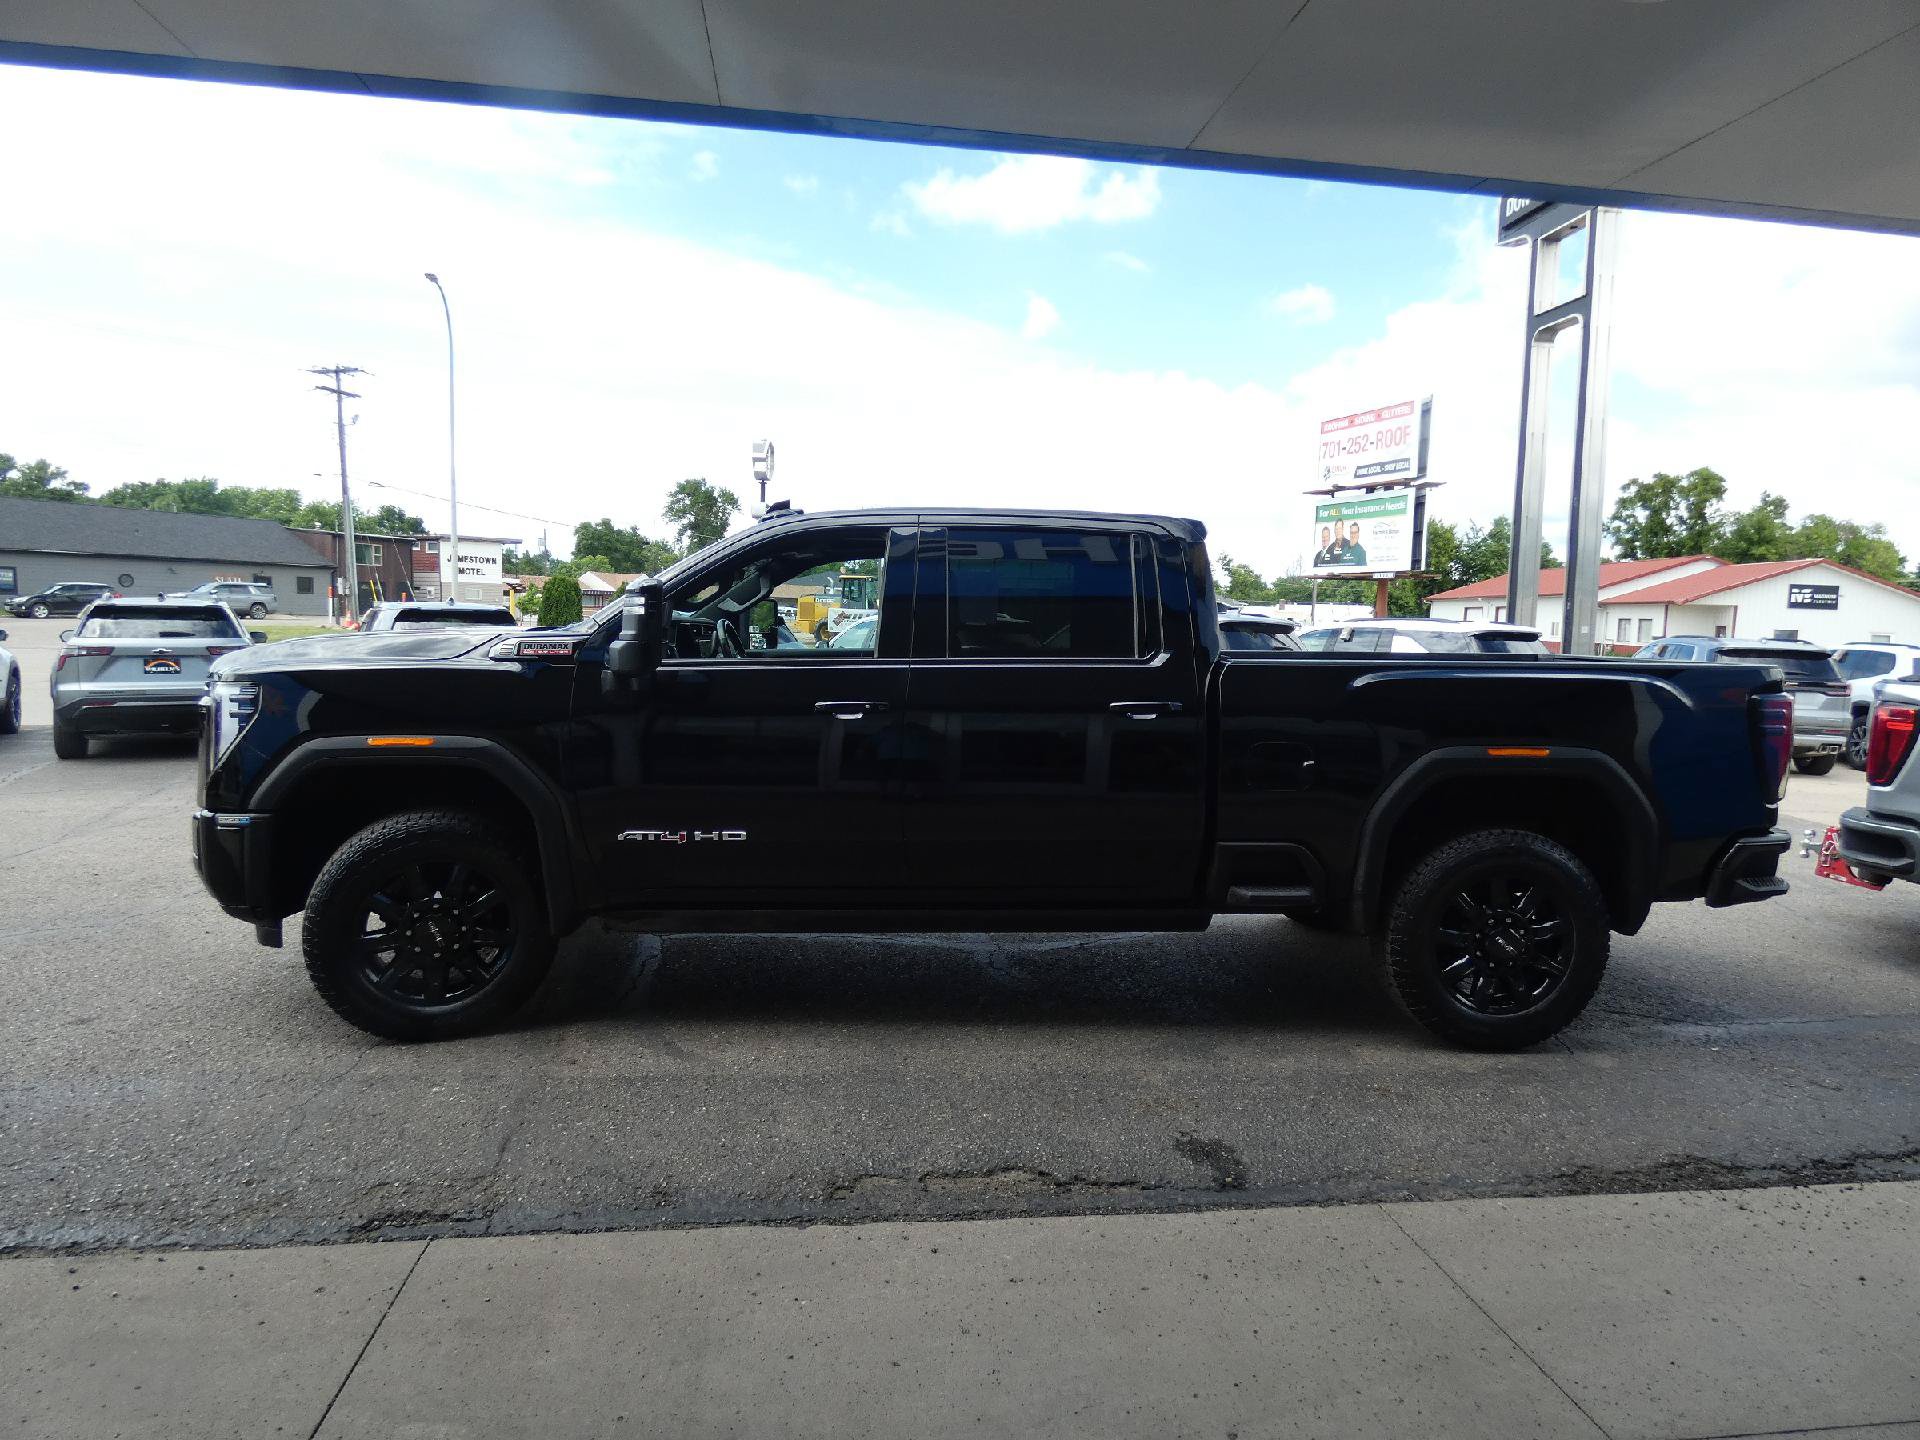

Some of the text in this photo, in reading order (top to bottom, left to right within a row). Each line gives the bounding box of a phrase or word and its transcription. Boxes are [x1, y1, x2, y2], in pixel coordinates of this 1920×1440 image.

[1322, 425, 1411, 459] 701-252-ROOF
[1320, 509, 1329, 517] For
[1330, 508, 1340, 516] ALL
[1355, 503, 1385, 514] Insurance
[447, 554, 497, 565] JMESTOWN
[458, 567, 486, 576] MOTEL
